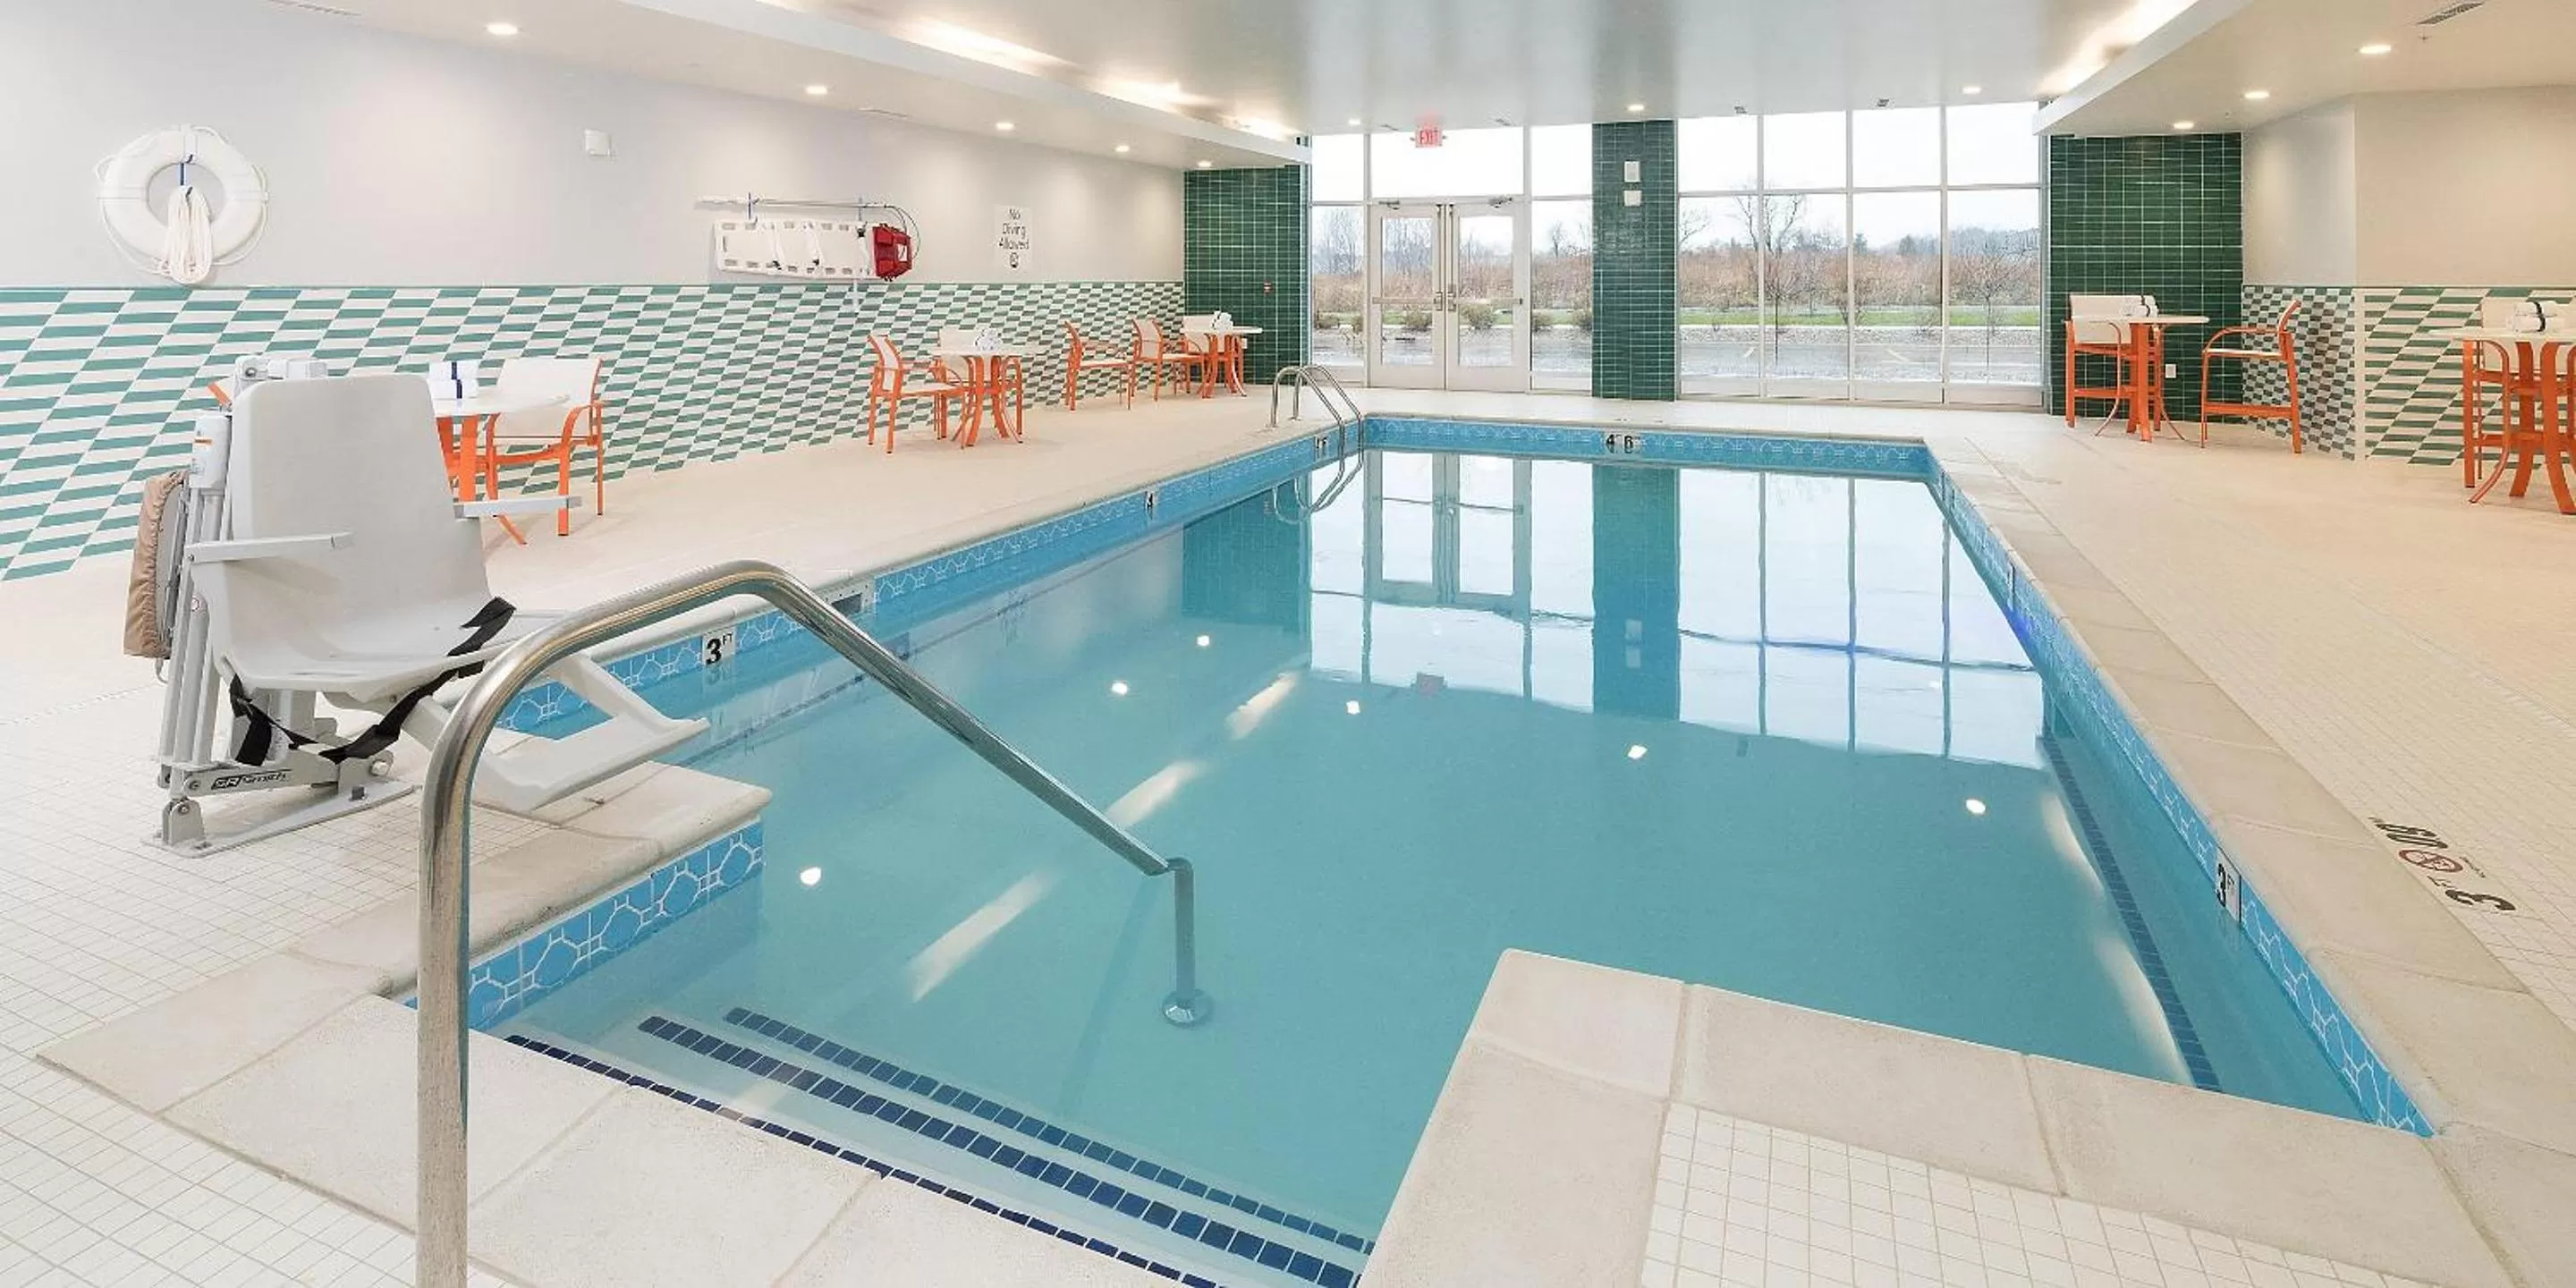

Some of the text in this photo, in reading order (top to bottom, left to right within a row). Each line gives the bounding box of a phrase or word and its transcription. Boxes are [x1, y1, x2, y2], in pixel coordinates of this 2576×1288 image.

[1419, 130, 1439, 145] EXIT
[1009, 208, 1021, 220] No
[1003, 222, 1026, 239] Diving
[999, 237, 1030, 250] Allowed
[706, 638, 722, 665] 3
[2217, 863, 2226, 907] 3
[2445, 889, 2516, 911] 3
